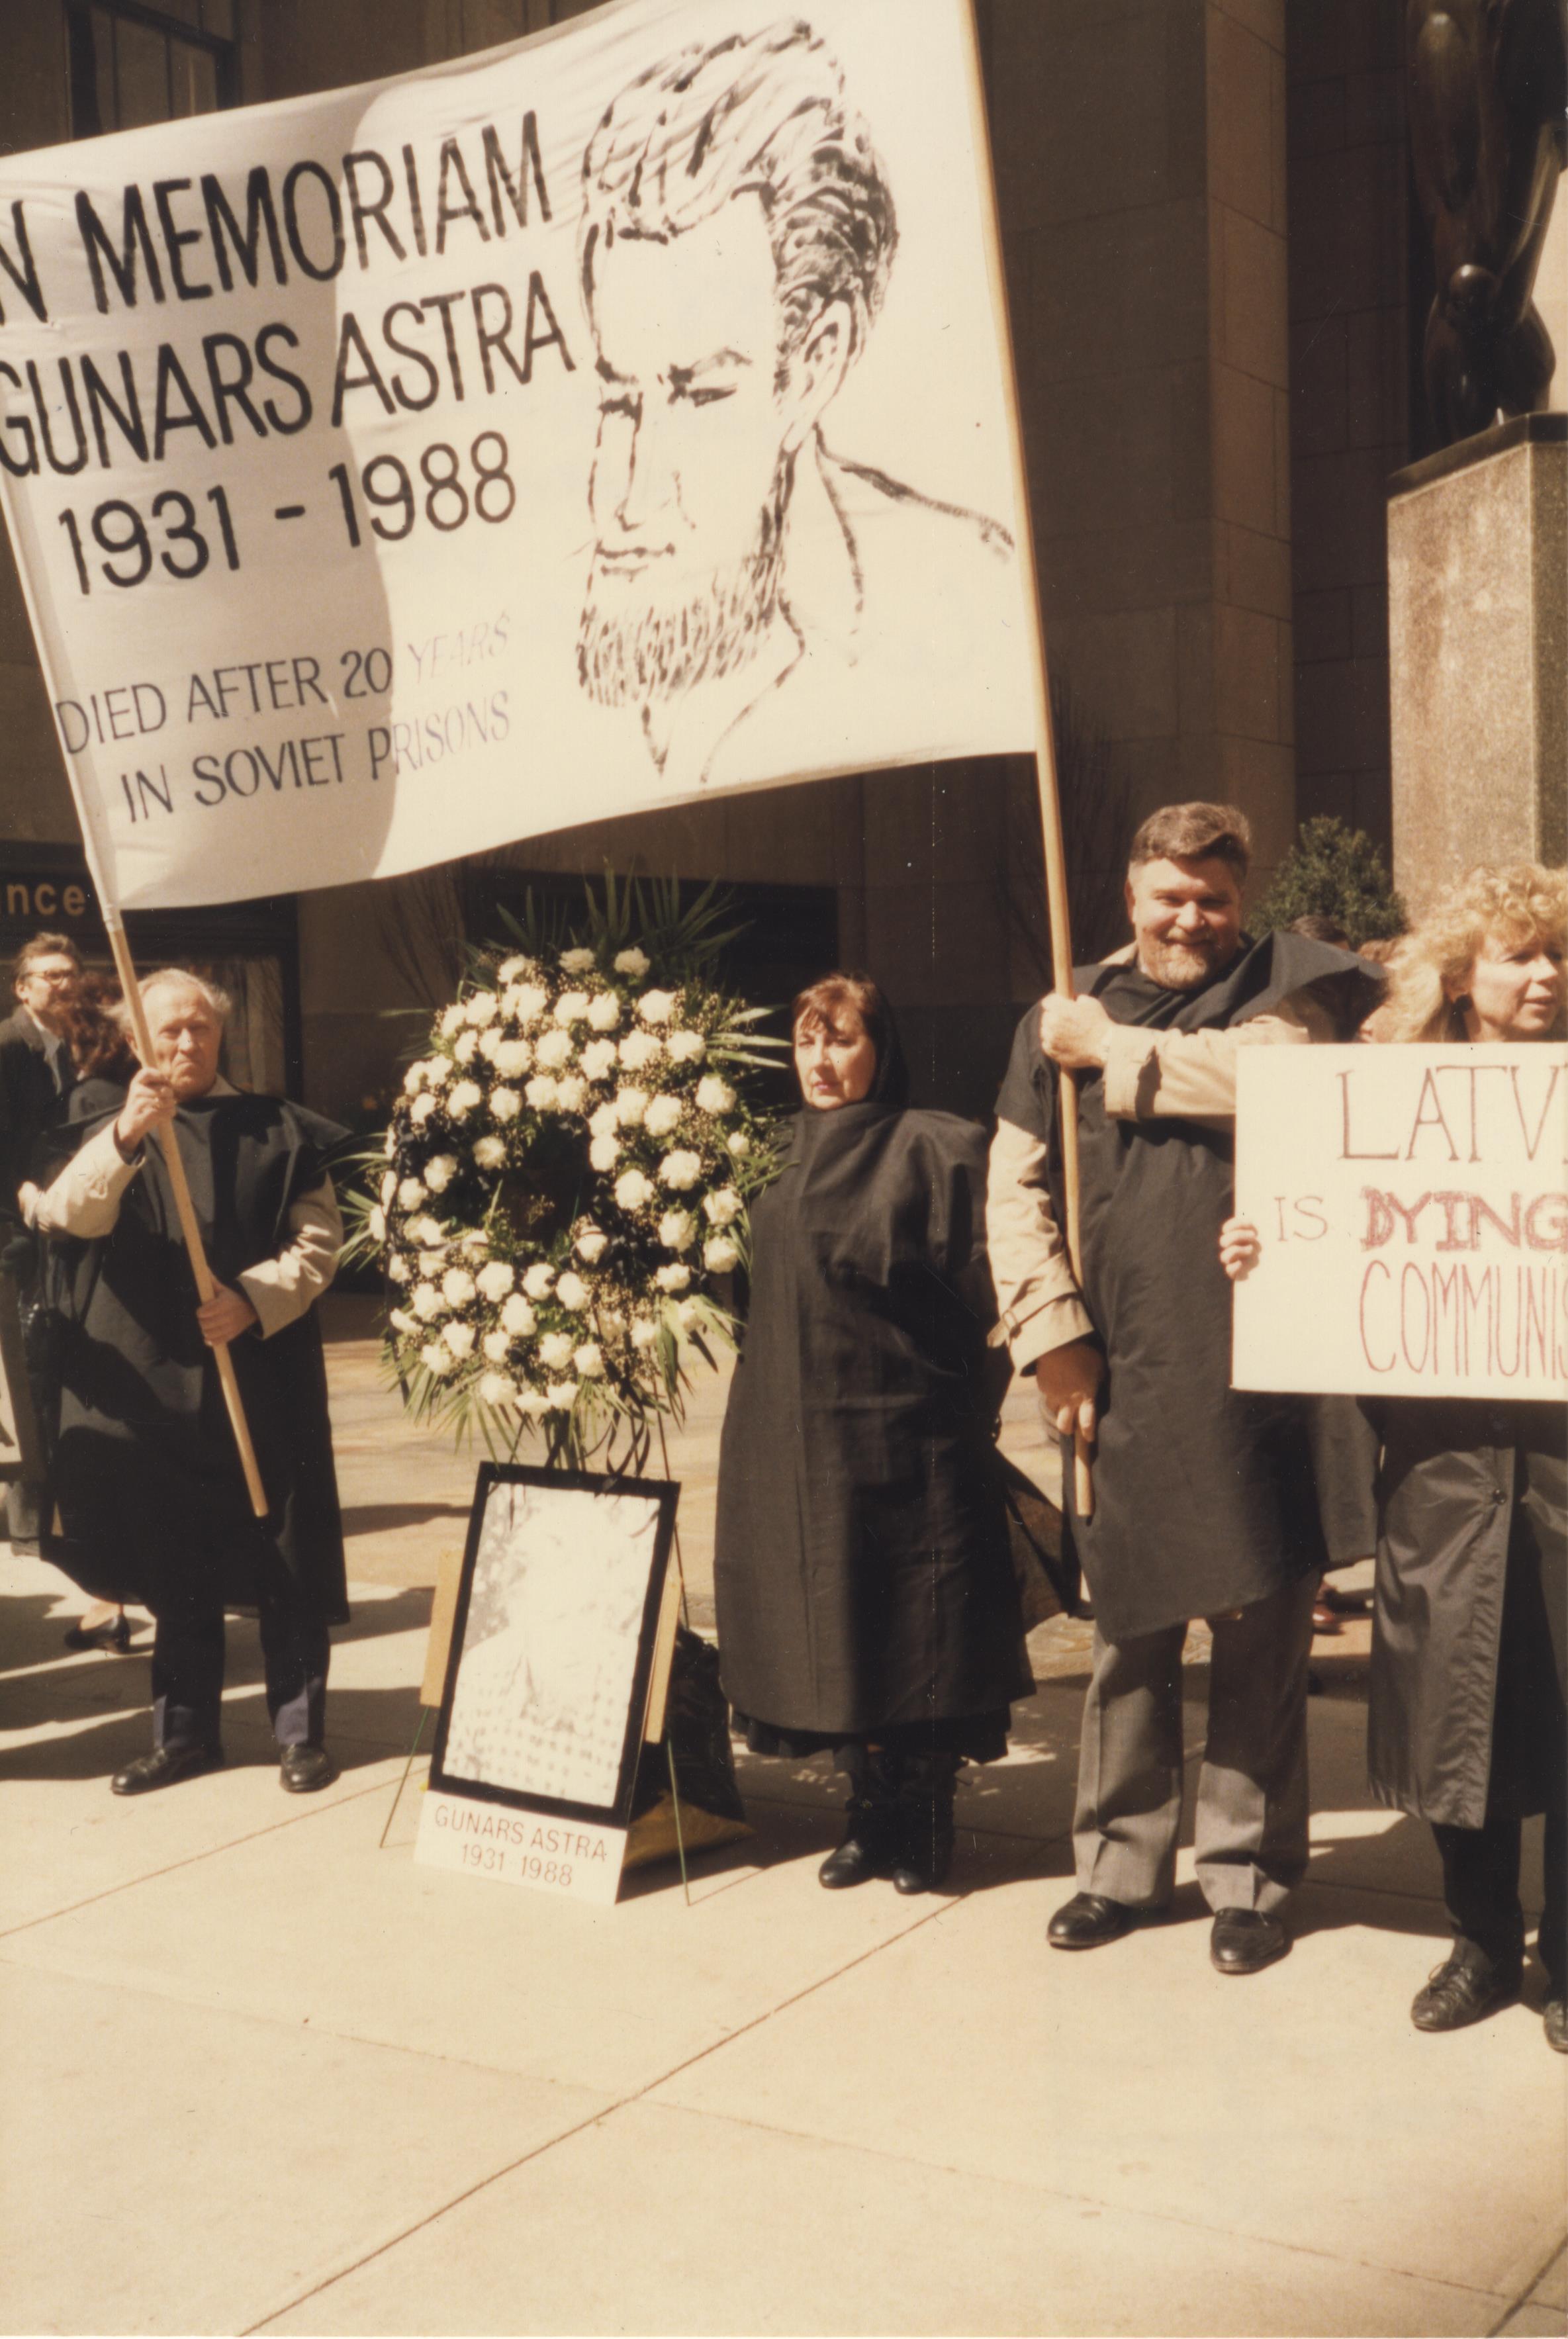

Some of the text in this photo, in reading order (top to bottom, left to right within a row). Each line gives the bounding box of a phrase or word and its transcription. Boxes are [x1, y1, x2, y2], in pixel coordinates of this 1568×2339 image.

[75, 110, 553, 314] MEMORIAM
[0, 270, 576, 477] GUNARS ASTRA
[58, 431, 516, 595] 1931 - 1988
[55, 610, 510, 755] DIED AFTER 20 YEARS
[120, 690, 510, 823] IN SOVIET PRISONS
[7, 883, 86, 916] nce
[1335, 1063, 1568, 1165] LATV
[1274, 1185, 1568, 1254] IS DYING
[434, 1804, 607, 1863] GUNARS ASTRA
[462, 1843, 573, 1887] 1931 1988
